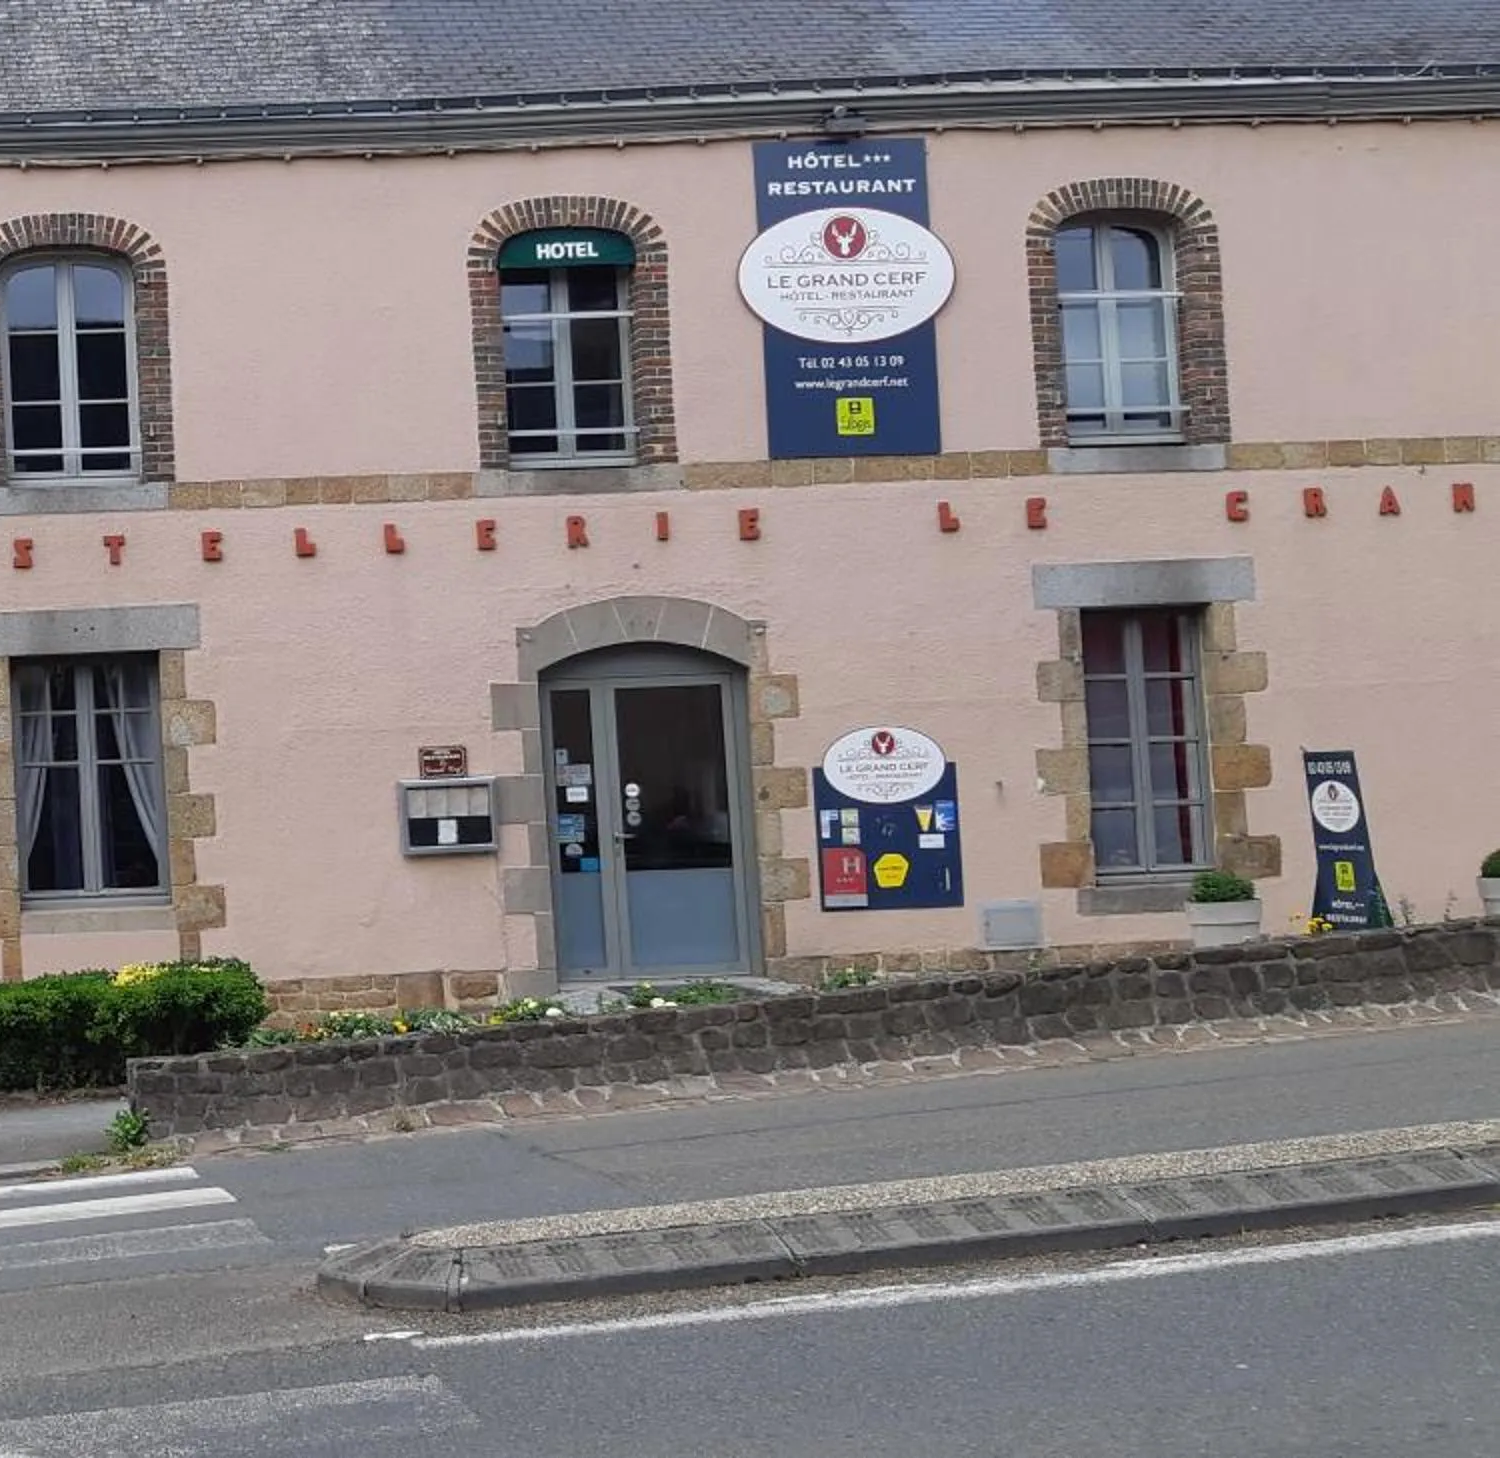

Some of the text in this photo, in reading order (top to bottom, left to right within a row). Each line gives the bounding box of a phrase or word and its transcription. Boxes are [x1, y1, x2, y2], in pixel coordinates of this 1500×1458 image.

[767, 178, 916, 196] RESTAURANT
[535, 241, 599, 260] HOTEL
[767, 271, 927, 289] LE GRAND CERF
[831, 288, 915, 299] RESTAURANT
[821, 357, 836, 369] 02
[838, 356, 853, 368] 43
[855, 355, 870, 367] 05
[873, 355, 887, 367] 13
[937, 497, 1047, 532] LE
[856, 762, 897, 773] GRAND
